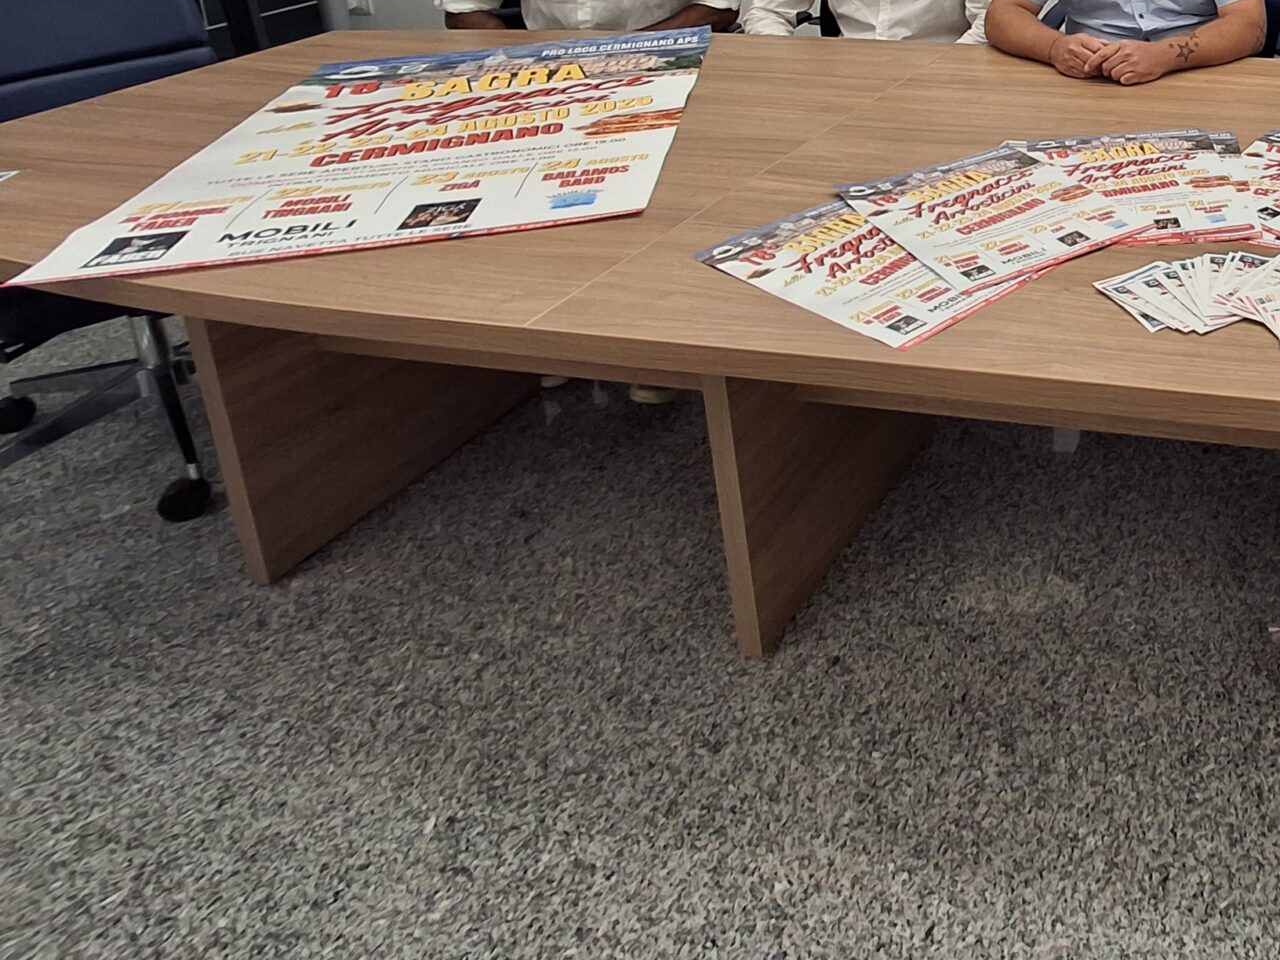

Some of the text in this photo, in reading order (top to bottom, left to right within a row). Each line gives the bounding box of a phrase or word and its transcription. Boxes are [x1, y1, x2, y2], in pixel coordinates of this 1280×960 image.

[542, 48, 564, 57] PRO
[568, 45, 598, 54] LOCO
[600, 38, 674, 52] CERMIGNANO
[678, 36, 698, 45] APS
[400, 63, 588, 100] SAGRA
[458, 107, 570, 133] AGOSTO
[579, 96, 653, 117] 2025
[309, 123, 564, 168] CERMIGNANO
[558, 176, 605, 188] BAND
[932, 180, 1037, 225] Arrosticini
[218, 219, 358, 243] MOBILI
[226, 231, 333, 248] TRIGNANI
[782, 226, 882, 274] Fregna
